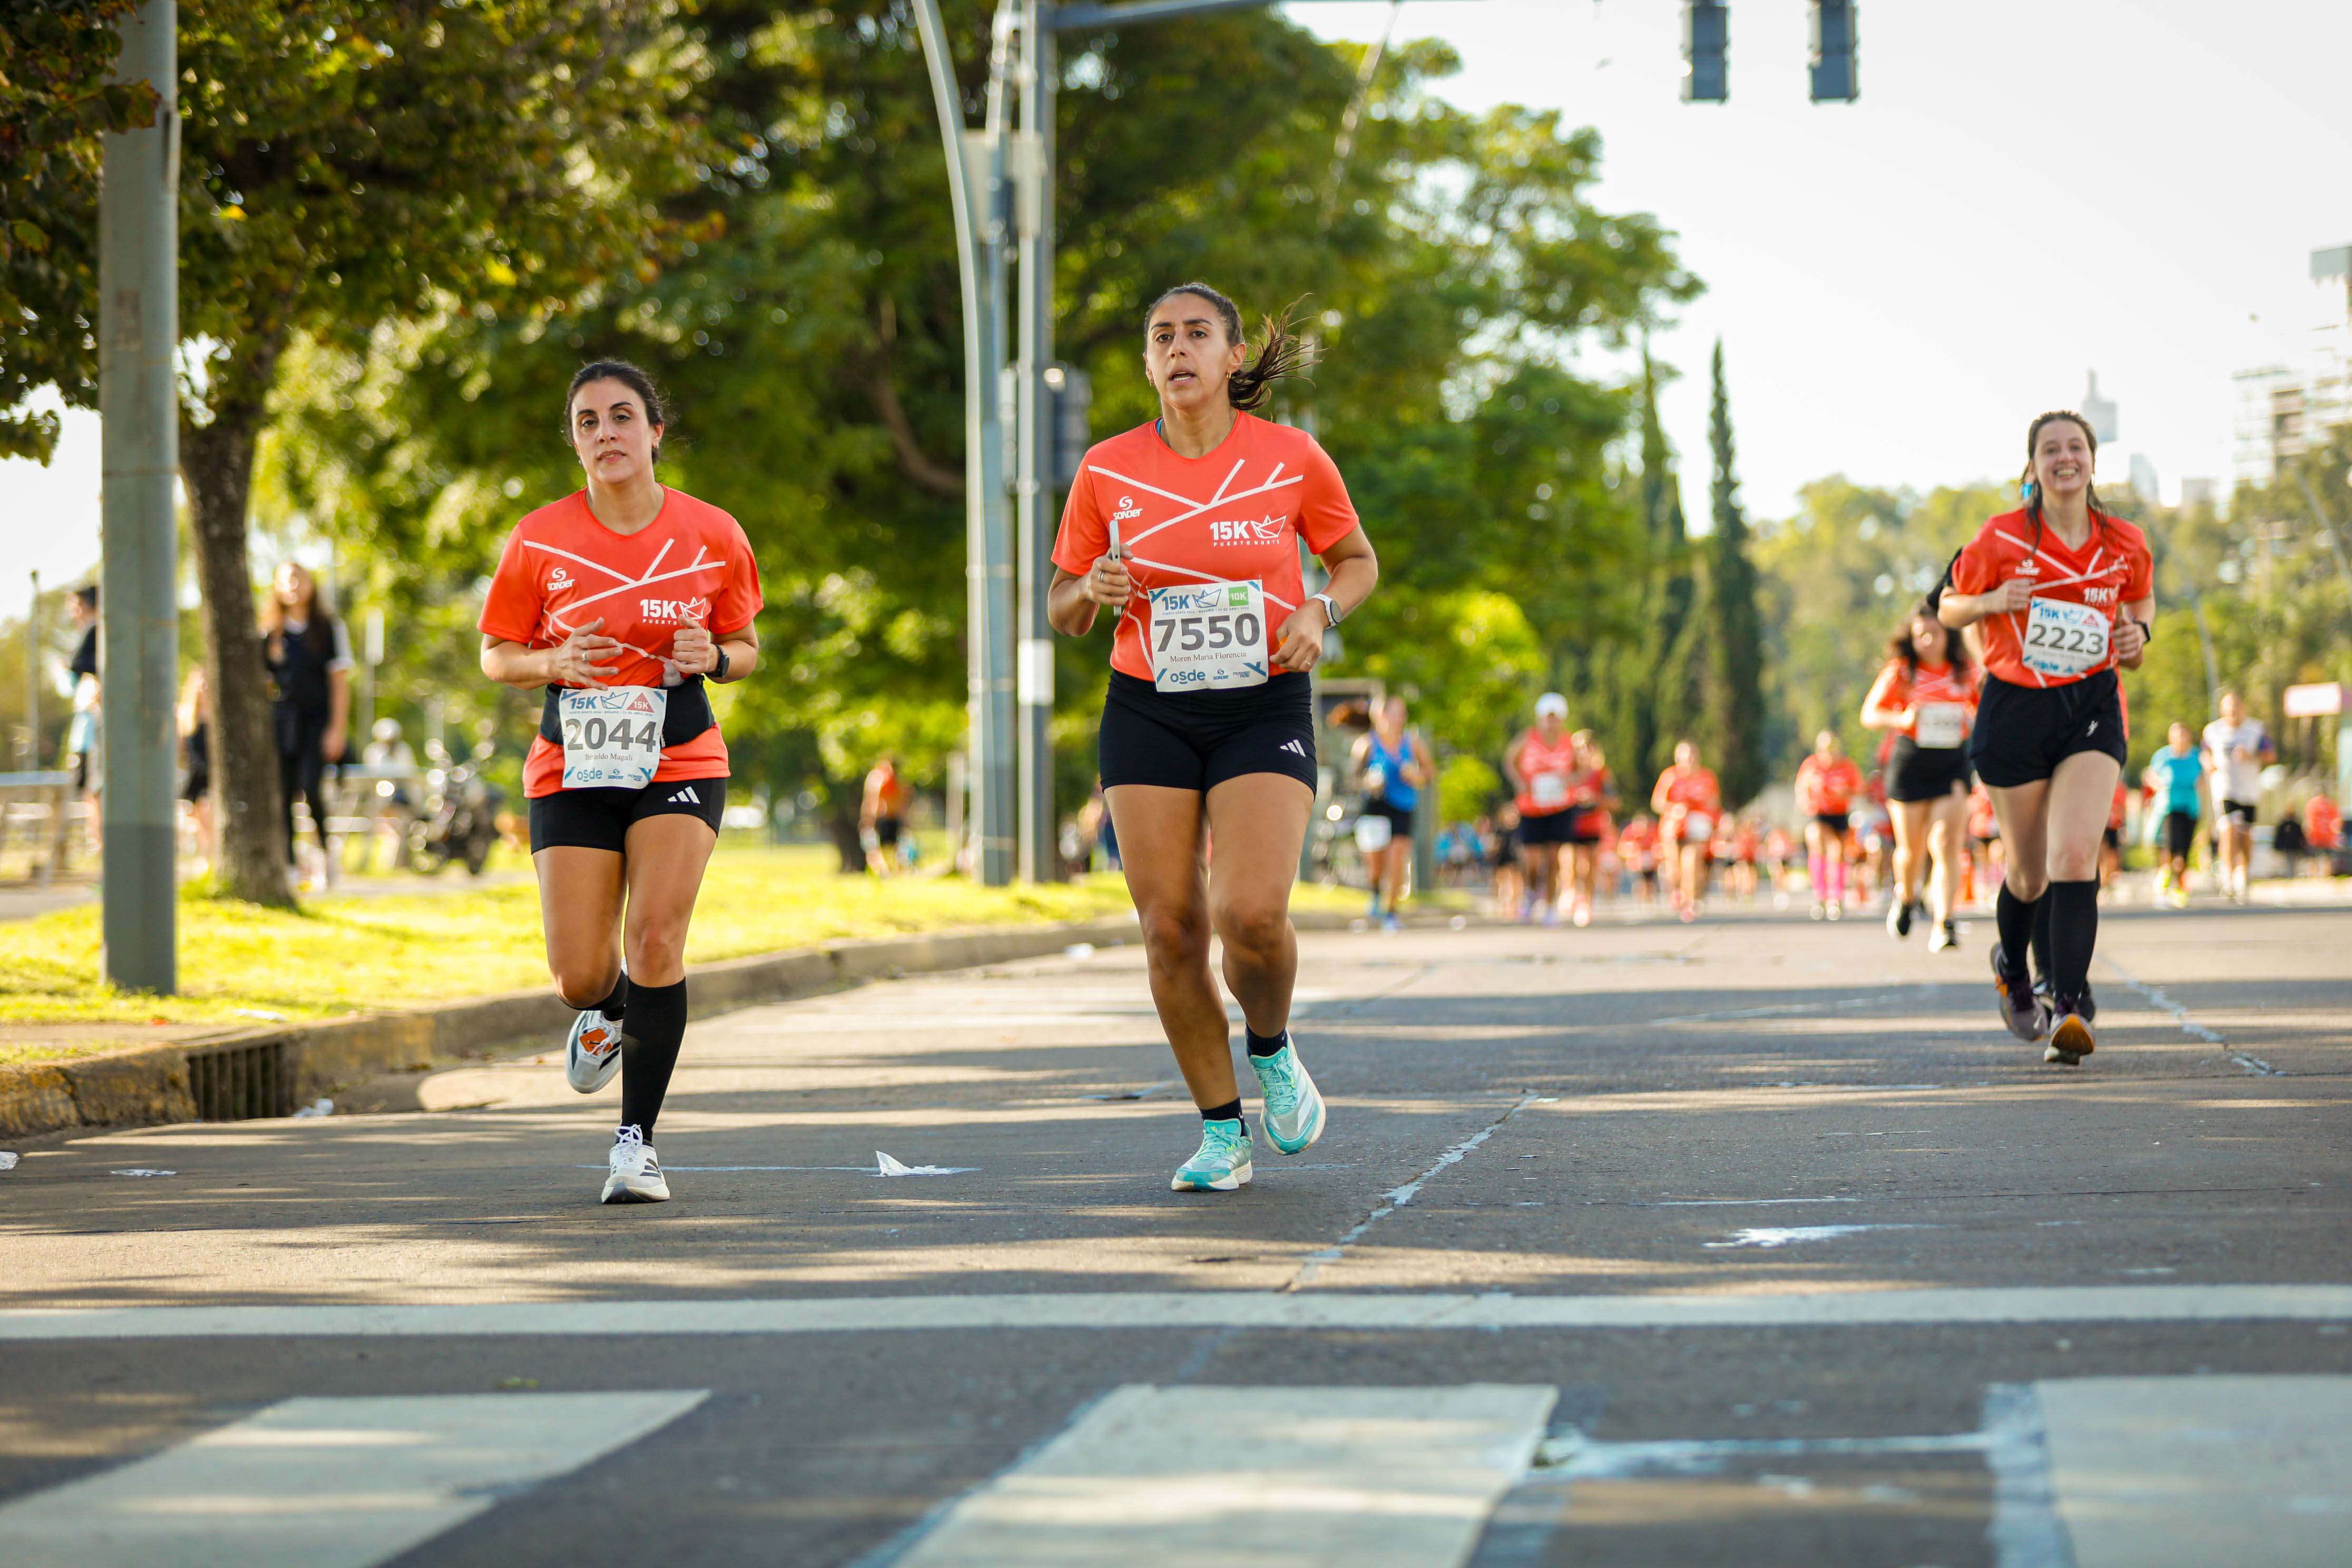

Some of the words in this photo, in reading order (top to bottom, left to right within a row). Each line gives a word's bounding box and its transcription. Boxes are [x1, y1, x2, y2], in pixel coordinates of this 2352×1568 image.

[1210, 521, 1250, 540] 15K
[1230, 592, 1247, 601] 10K
[2084, 587, 2109, 603] 15K
[640, 599, 678, 619] 15K
[1162, 594, 1190, 611] 15K
[2040, 606, 2060, 619] 15K
[1154, 613, 1260, 652] 7550
[2029, 624, 2104, 654] 2223
[1214, 651, 1247, 659] Florencia
[1170, 669, 1206, 683] osde
[571, 696, 598, 709] 15K
[633, 701, 649, 710] 15K
[565, 718, 657, 752] 2044
[611, 753, 633, 762] Magali
[577, 767, 603, 781] osde
